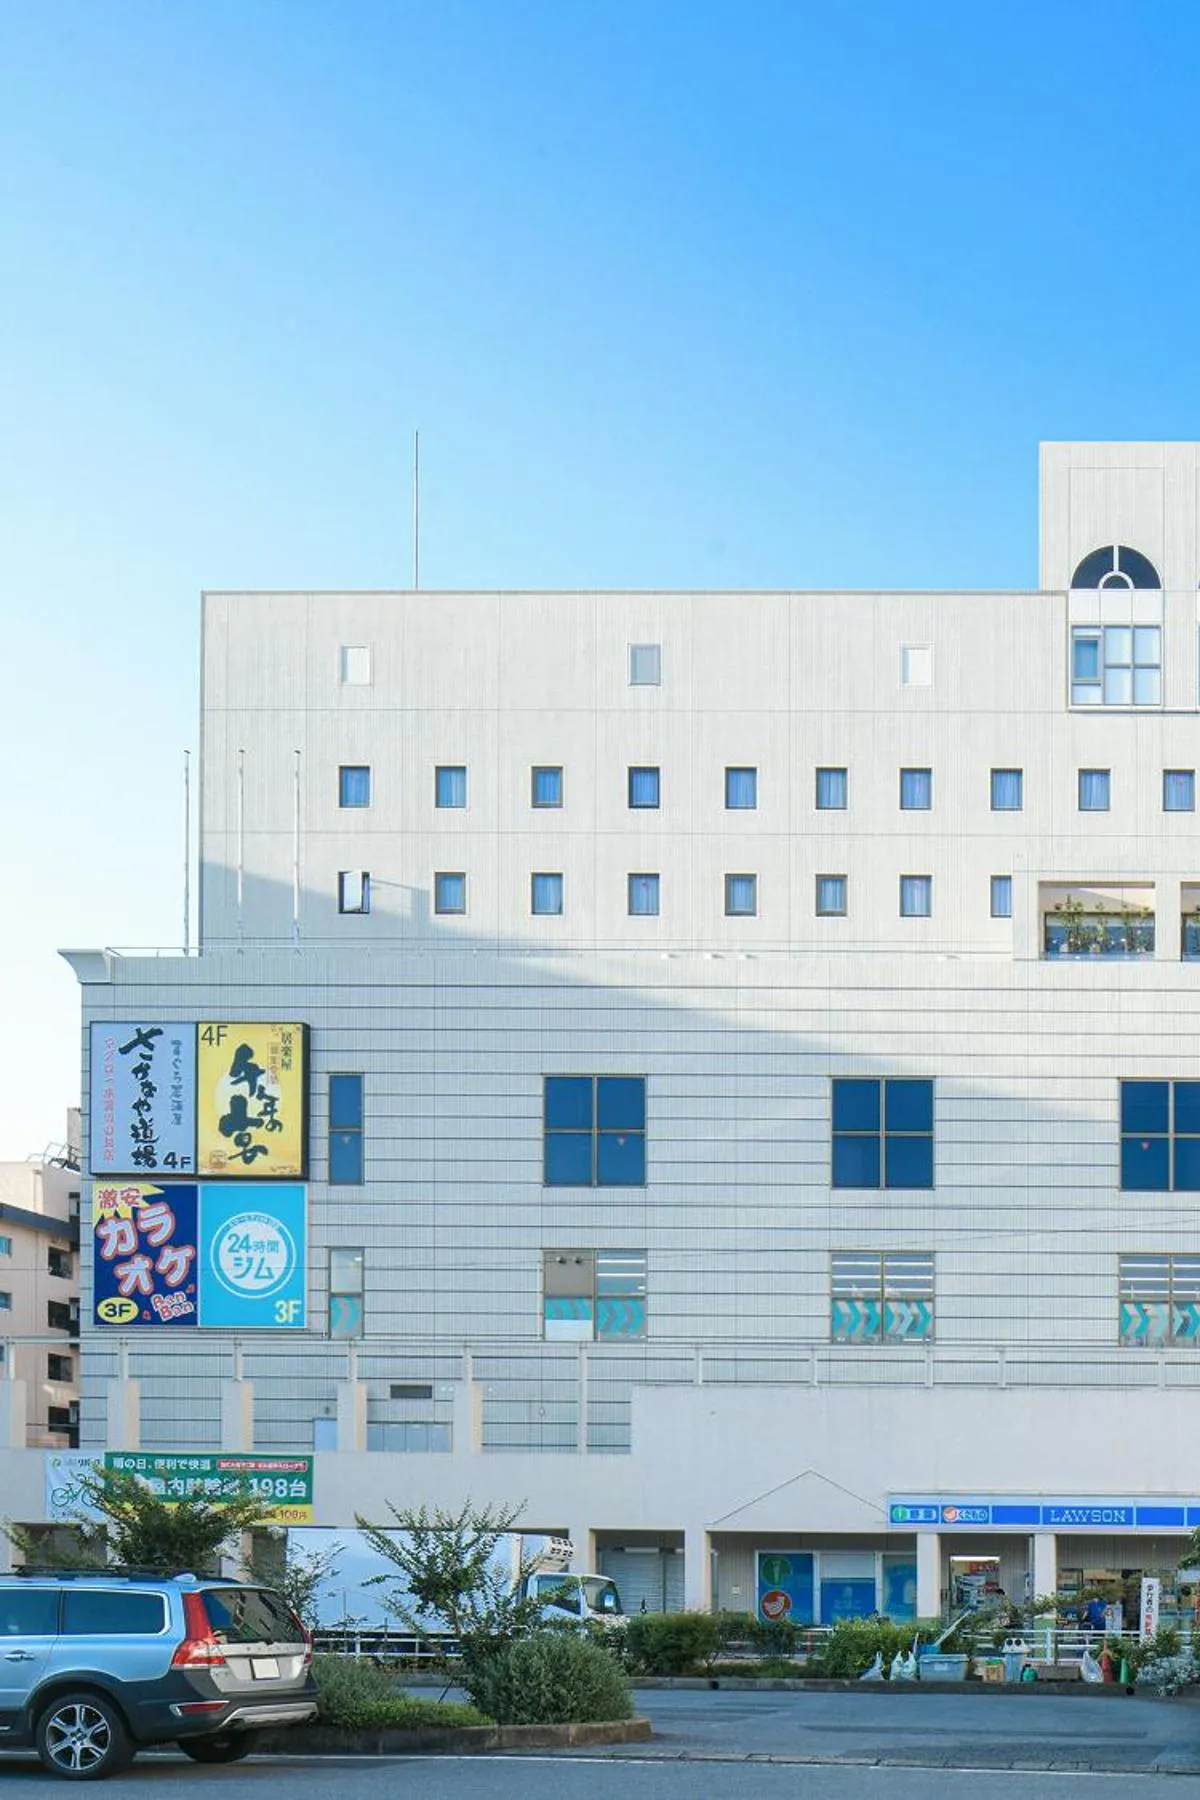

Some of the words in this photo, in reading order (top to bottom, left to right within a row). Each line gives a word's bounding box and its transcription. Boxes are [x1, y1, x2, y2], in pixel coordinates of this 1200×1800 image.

[201, 1026, 227, 1047] 4F
[118, 1027, 164, 1169] さかなや道場
[218, 1043, 283, 1165] 千年の宴
[163, 1152, 191, 1169] 4F
[98, 1186, 141, 1209] 激安
[96, 1201, 195, 1297] カラオケ
[227, 1233, 280, 1254] 24時間
[233, 1257, 275, 1280] ジム
[103, 1303, 132, 1318] 3F
[274, 1299, 302, 1323] 3F
[249, 1478, 307, 1498] 198台
[1050, 1509, 1127, 1523] LAWSON
